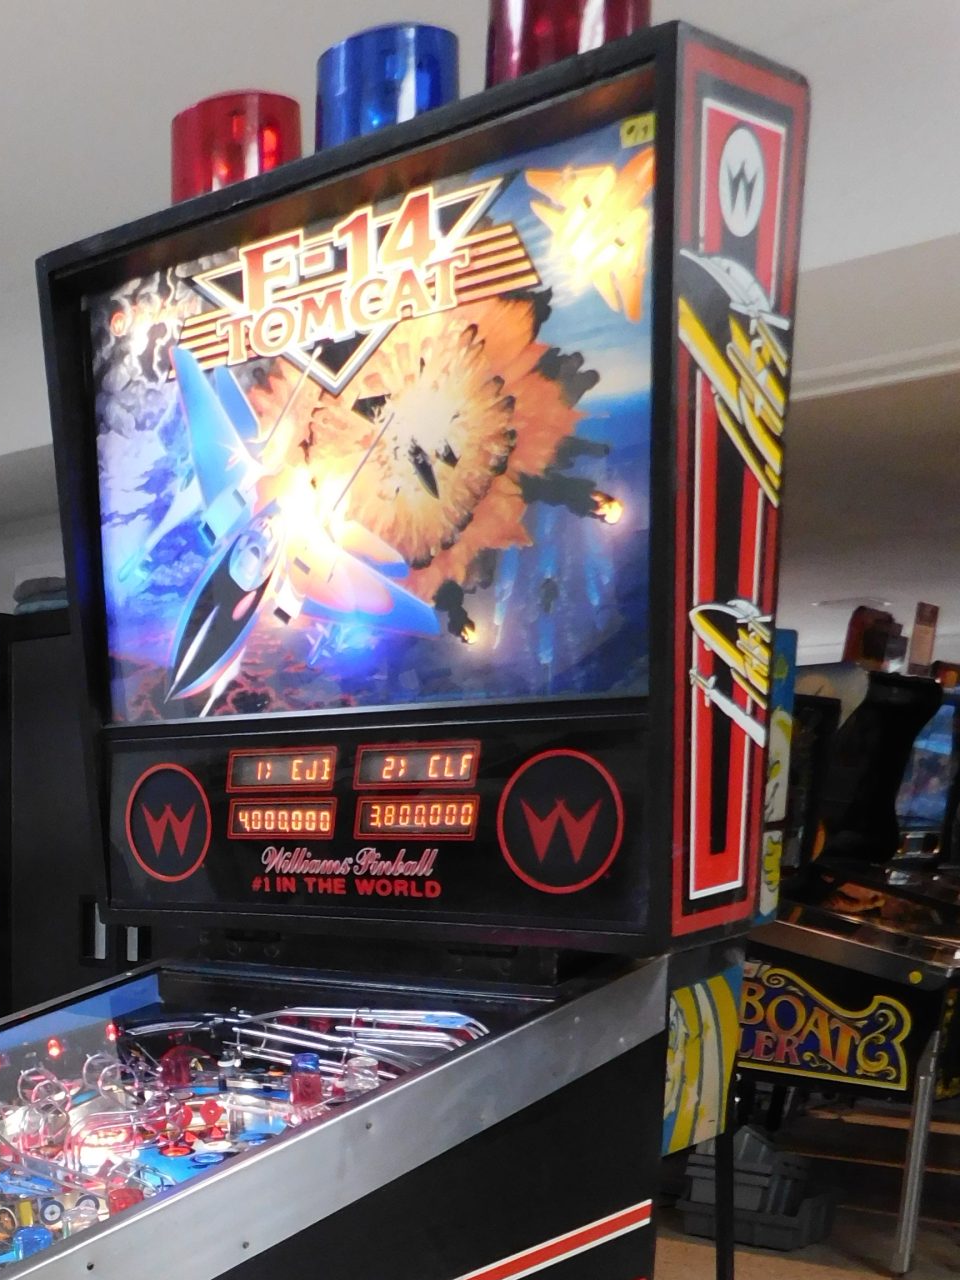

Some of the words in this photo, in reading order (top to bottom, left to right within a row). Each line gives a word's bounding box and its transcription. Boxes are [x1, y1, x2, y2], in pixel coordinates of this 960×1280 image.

[240, 187, 437, 312] F-14
[216, 249, 470, 365] TOMCAT
[428, 754, 473, 777] CLF
[261, 846, 353, 875] Williams
[353, 847, 439, 877] Pinball
[276, 877, 297, 893] IN
[303, 877, 346, 895] THE
[354, 878, 441, 898] WORLD
